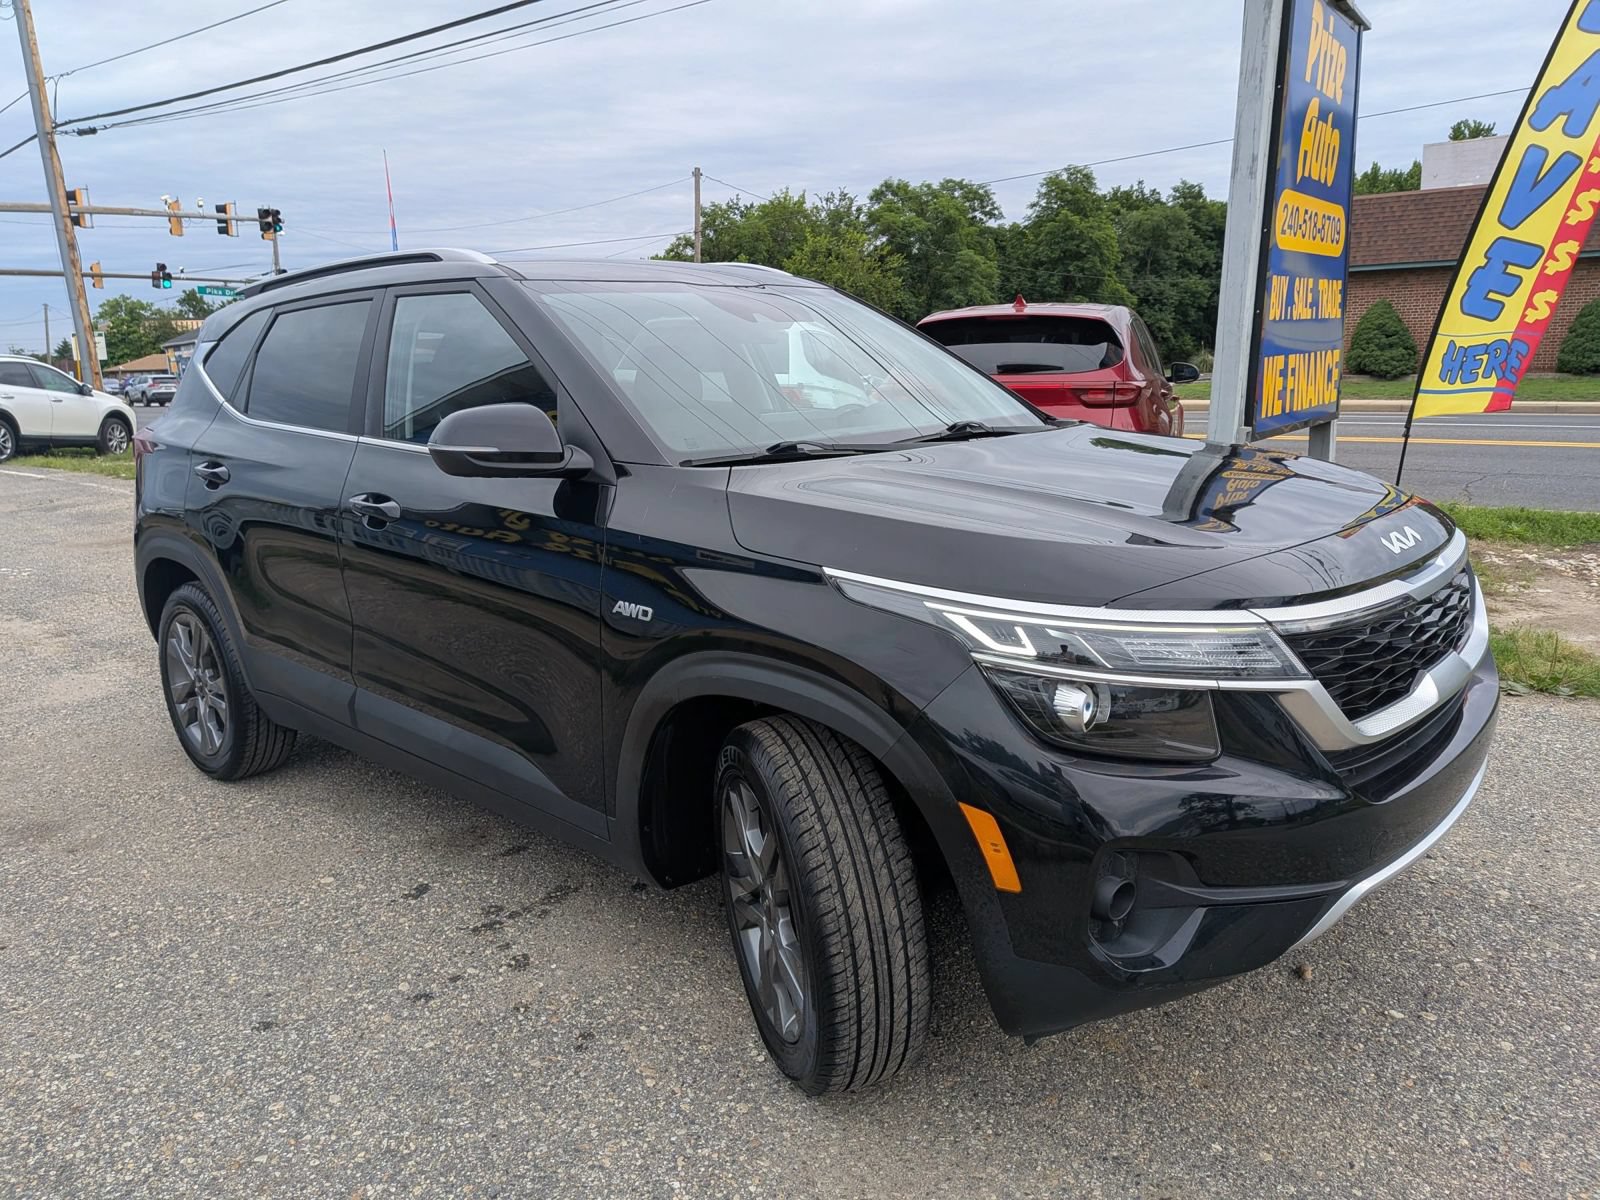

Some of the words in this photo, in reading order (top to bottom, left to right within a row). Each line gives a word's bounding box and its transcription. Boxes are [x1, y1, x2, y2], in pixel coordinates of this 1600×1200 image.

[1305, 0, 1347, 105] Prize
[1296, 97, 1340, 187] Auto
[1280, 203, 1341, 245] 240-518-8709
[1318, 279, 1342, 319] TRADE
[1261, 355, 1285, 418] WE
[1285, 349, 1340, 413] FINANCE
[1439, 339, 1530, 385] HERE
[1380, 526, 1422, 554] KIA
[612, 600, 653, 621] AWD
